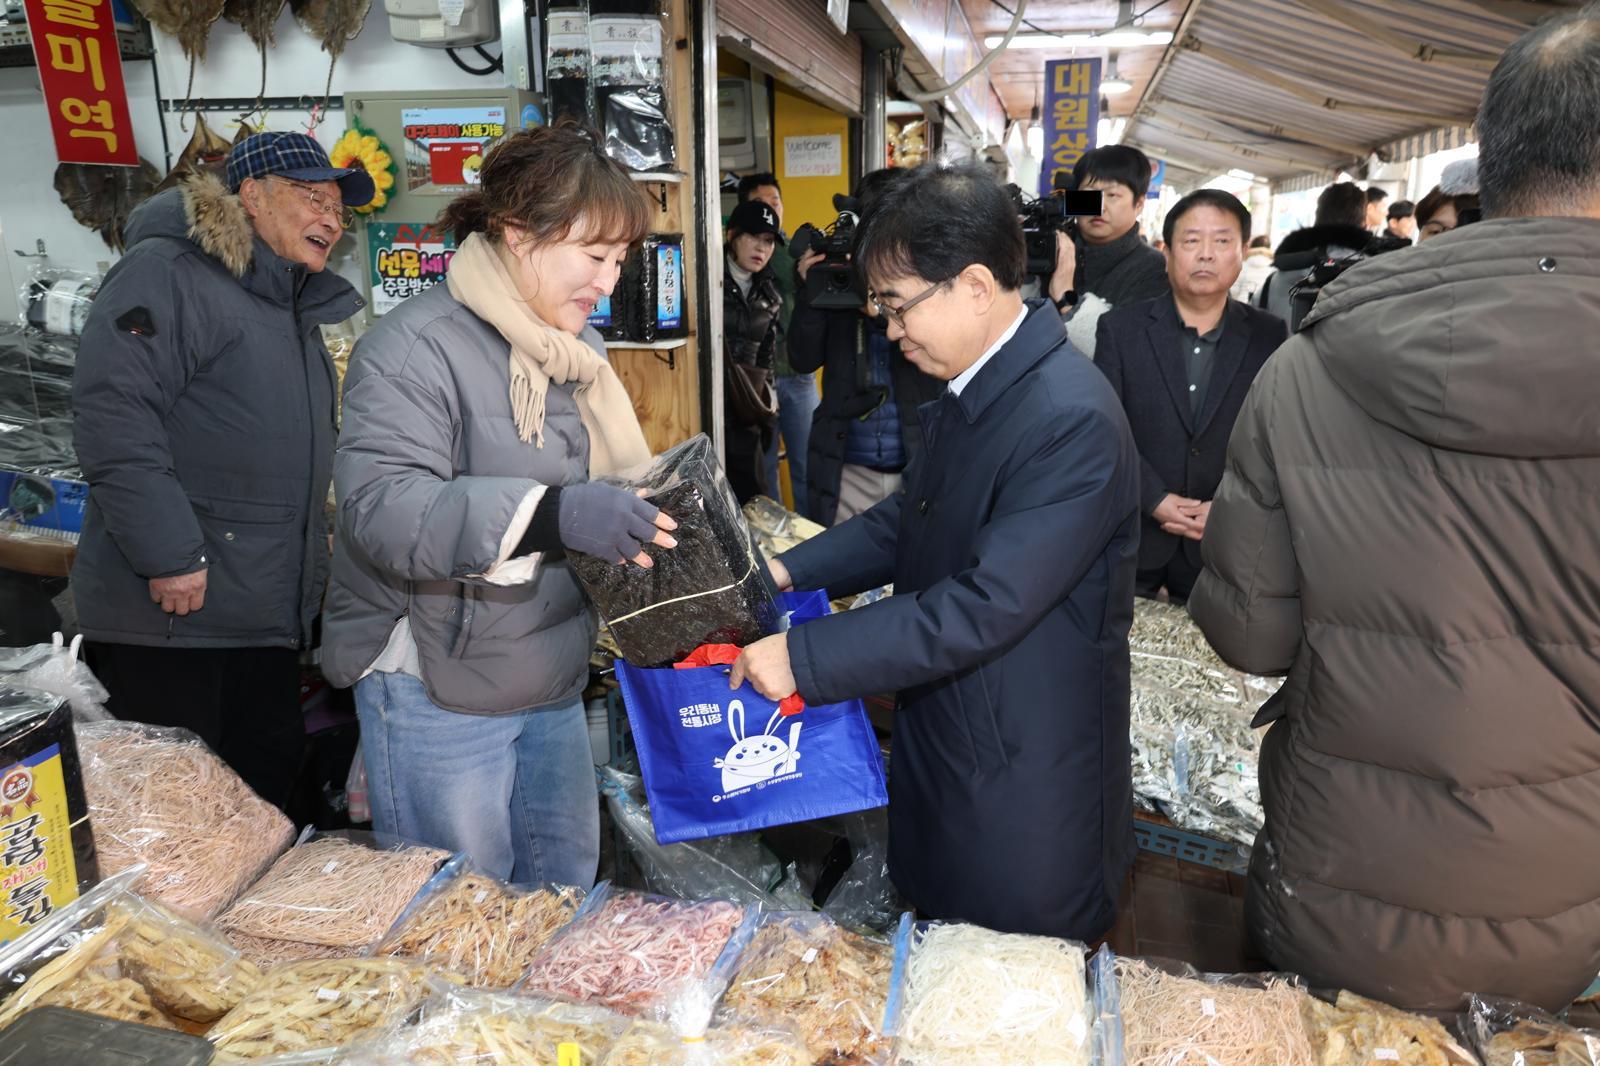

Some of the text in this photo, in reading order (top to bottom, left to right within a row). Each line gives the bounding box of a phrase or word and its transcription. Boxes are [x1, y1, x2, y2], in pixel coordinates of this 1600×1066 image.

[461, 122, 504, 137] 사용가능
[679, 703, 719, 717] 우리동네
[681, 714, 722, 727] 전통시장
[0, 813, 48, 867] 곱창
[7, 876, 53, 927] 돌김
